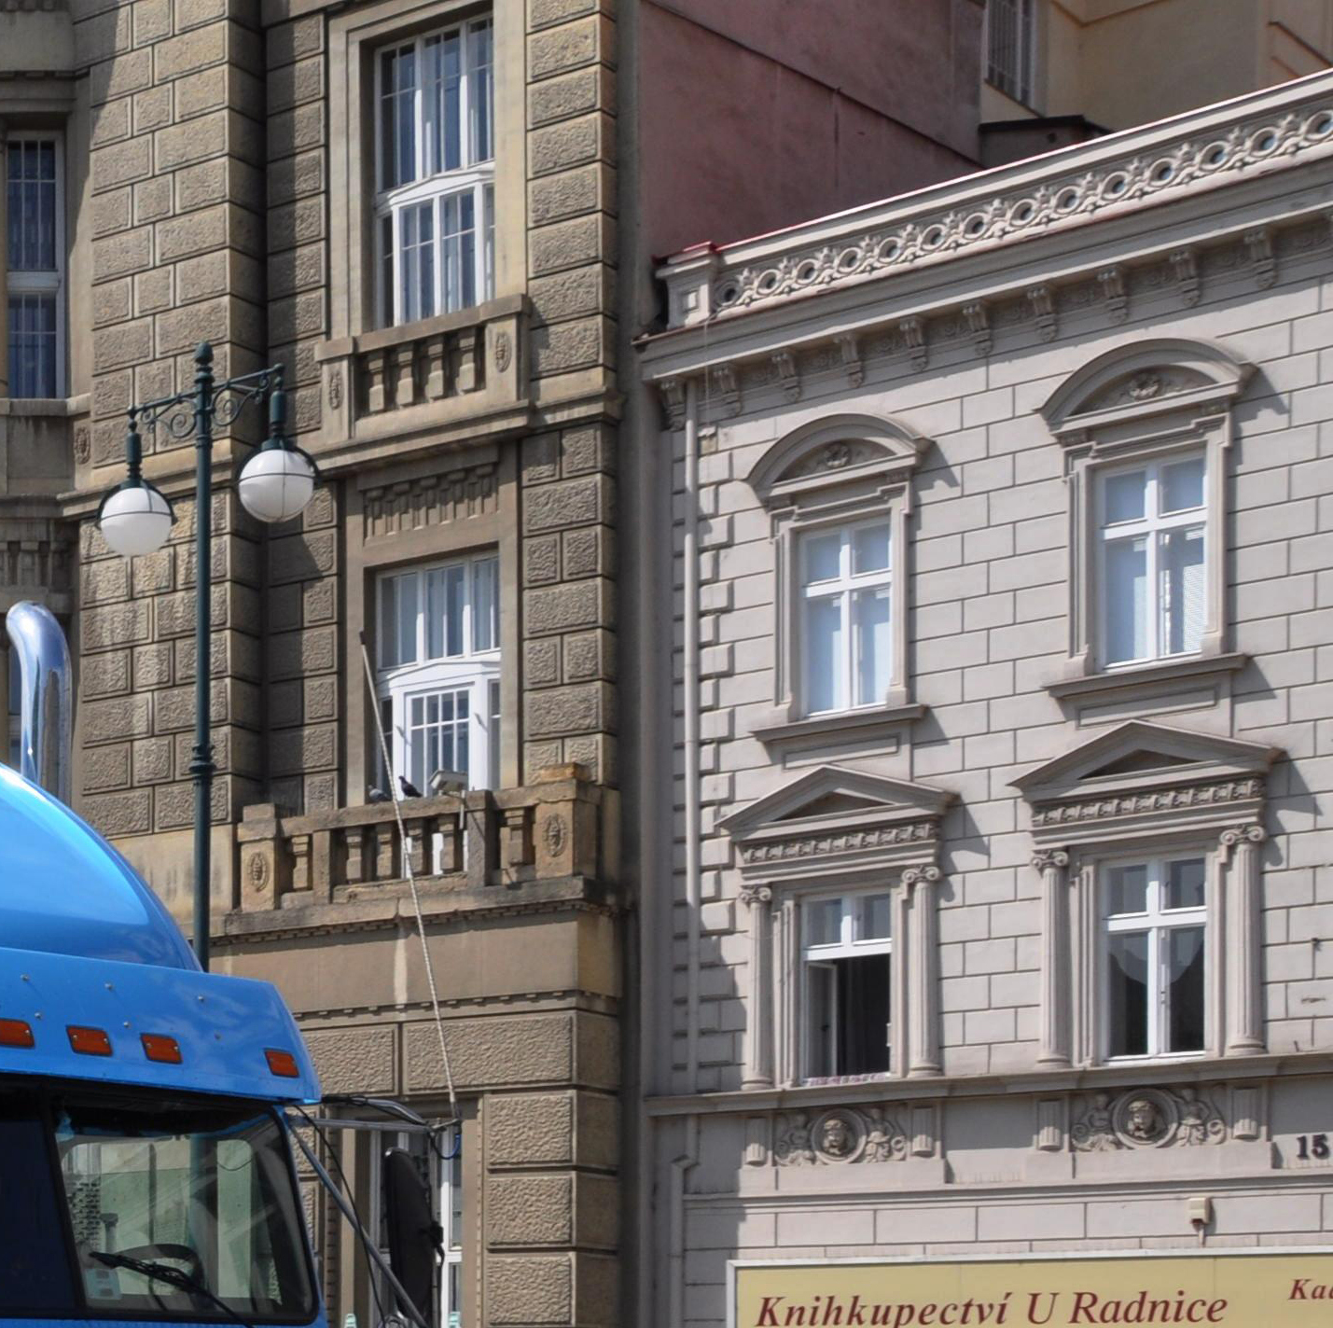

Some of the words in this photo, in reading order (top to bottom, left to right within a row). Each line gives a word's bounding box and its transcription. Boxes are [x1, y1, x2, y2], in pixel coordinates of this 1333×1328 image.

[1296, 1134, 1331, 1160] 15
[1027, 1292, 1060, 1326] U
[1069, 1289, 1229, 1325] Radnice
